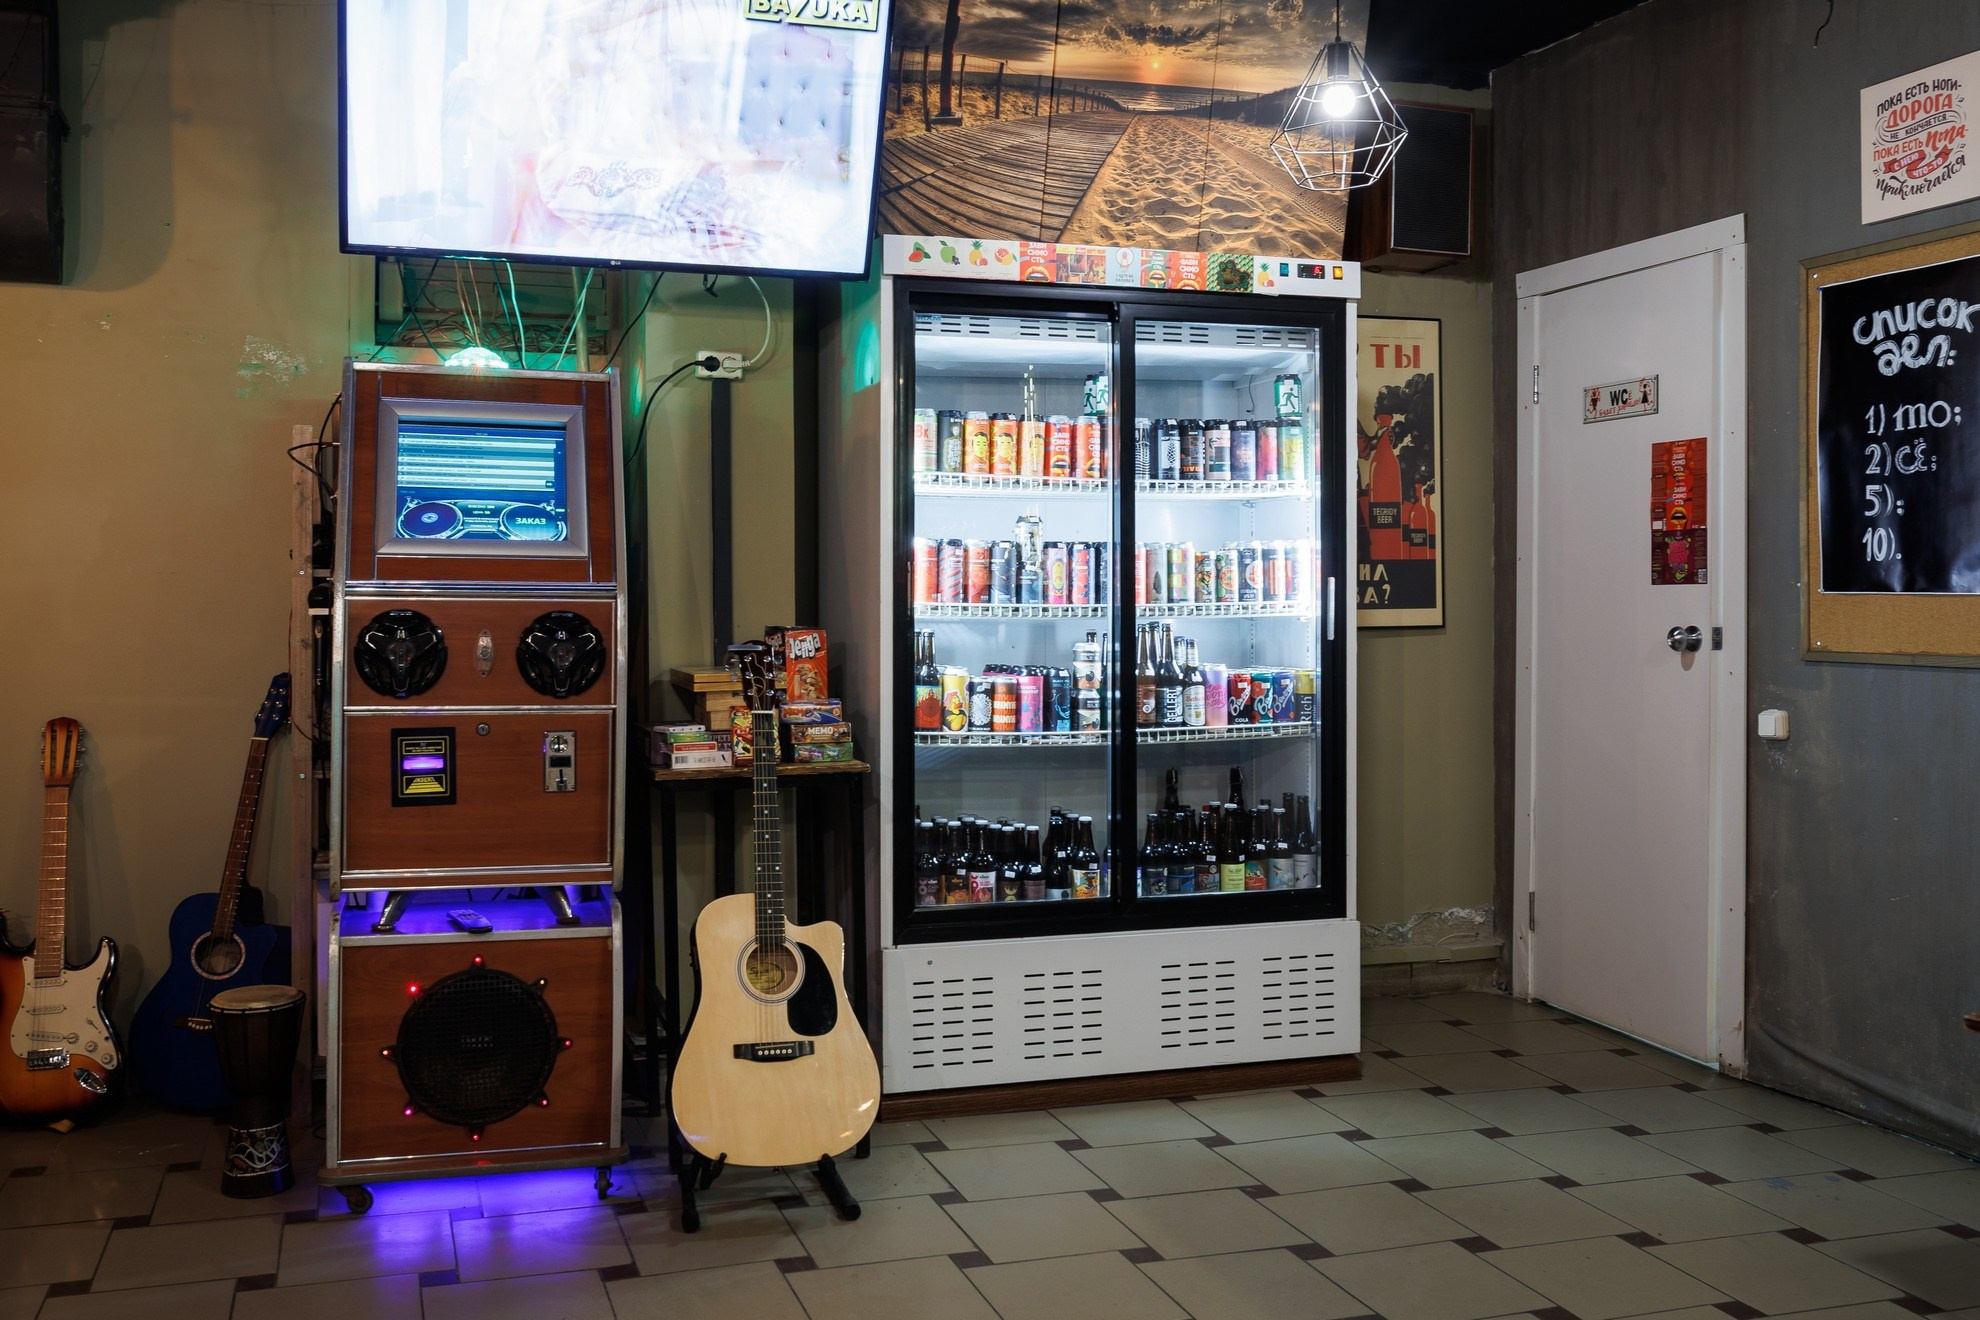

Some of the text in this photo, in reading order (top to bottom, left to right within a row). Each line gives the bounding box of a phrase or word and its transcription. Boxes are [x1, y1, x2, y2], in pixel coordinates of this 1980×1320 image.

[1876, 91, 1902, 117] ПОКА
[1905, 81, 1929, 100] ЕСТЬ
[1886, 94, 1953, 129] ДОРОГА
[1890, 131, 1900, 140] НЕ
[1873, 146, 1900, 162] ПОКА
[1902, 137, 1924, 152] ЕСТЬ
[1370, 344, 1420, 368] ТЫ
[1373, 508, 1397, 516] TEGRIDY
[1377, 516, 1393, 524] BEER
[789, 632, 821, 659] Jenga
[1300, 696, 1312, 722] Rich
